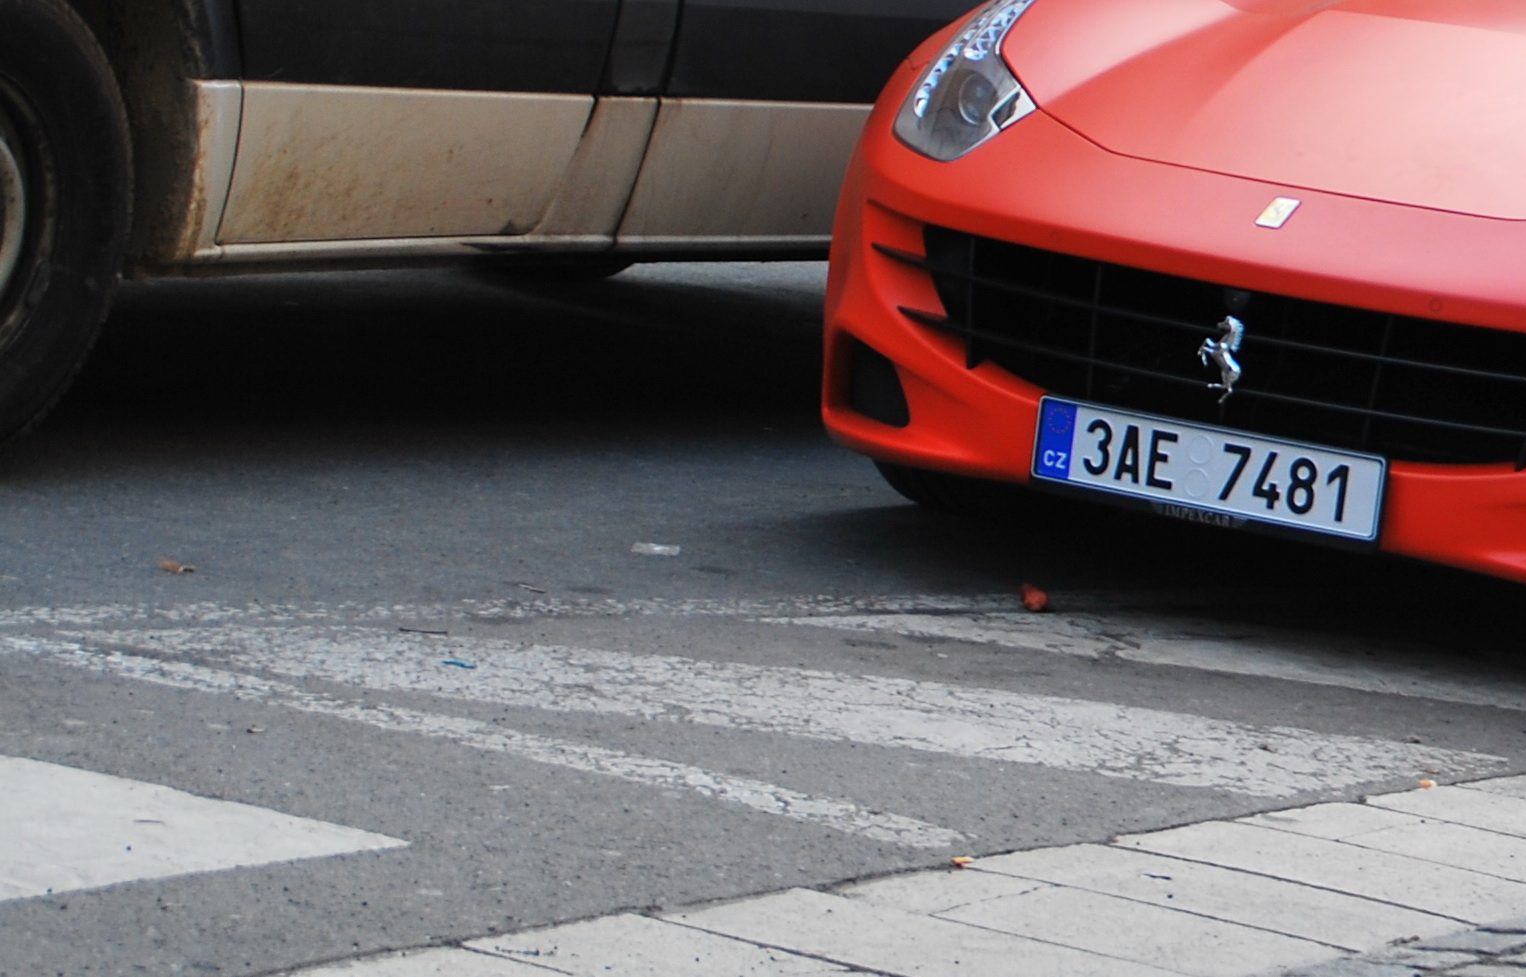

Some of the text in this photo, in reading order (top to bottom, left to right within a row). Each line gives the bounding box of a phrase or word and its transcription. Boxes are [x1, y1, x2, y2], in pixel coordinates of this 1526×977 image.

[1043, 449, 1067, 470] CZ
[1082, 418, 1350, 523] 3AE 7481
[1165, 504, 1230, 528] IMPEXCAR
